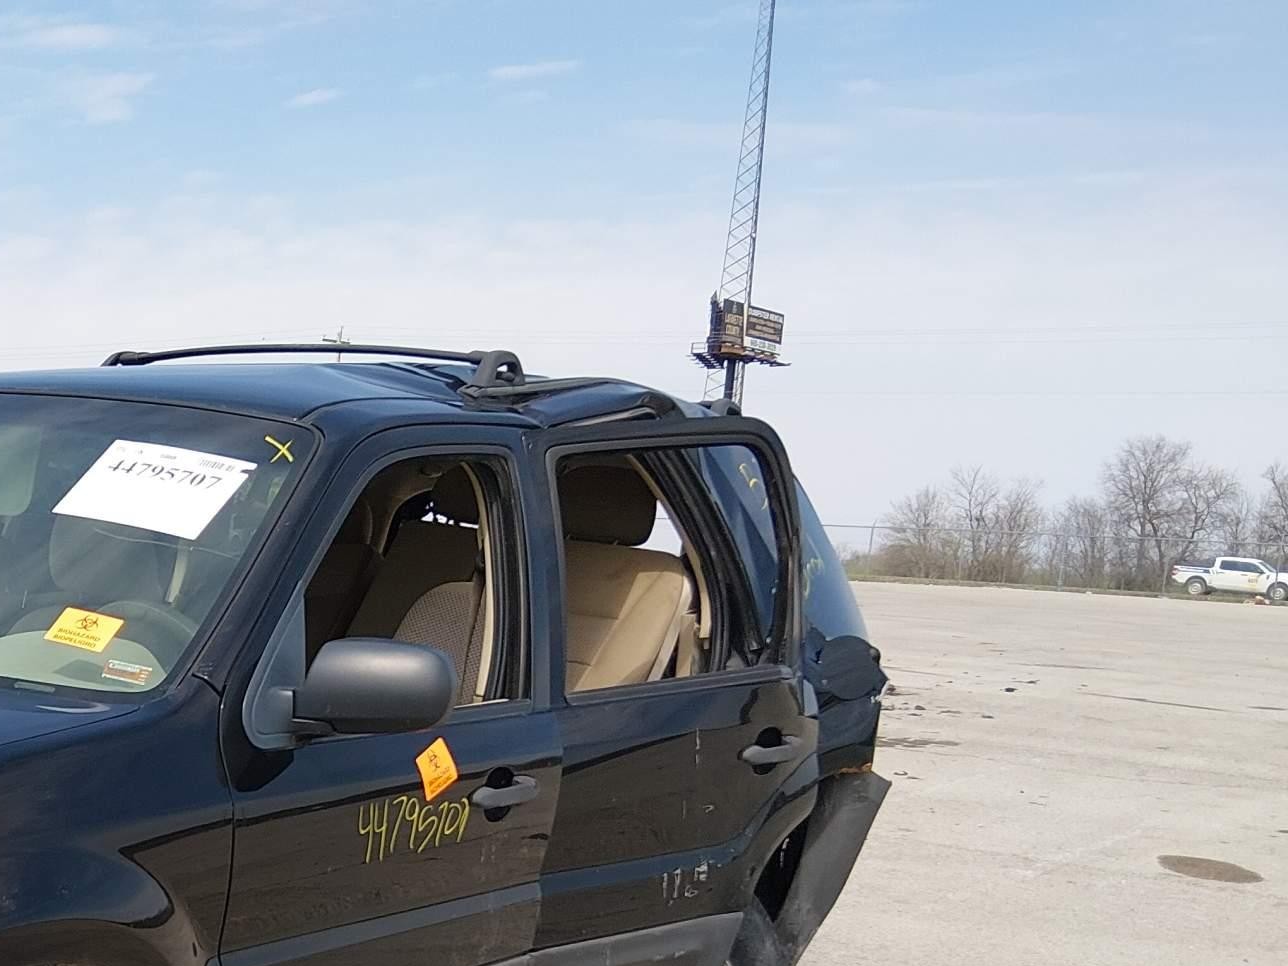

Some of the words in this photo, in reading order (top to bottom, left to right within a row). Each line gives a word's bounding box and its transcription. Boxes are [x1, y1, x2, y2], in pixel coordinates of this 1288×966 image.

[108, 459, 223, 489] 44795707
[57, 628, 101, 642] BIOHAZARD
[358, 795, 470, 864] 44795707
